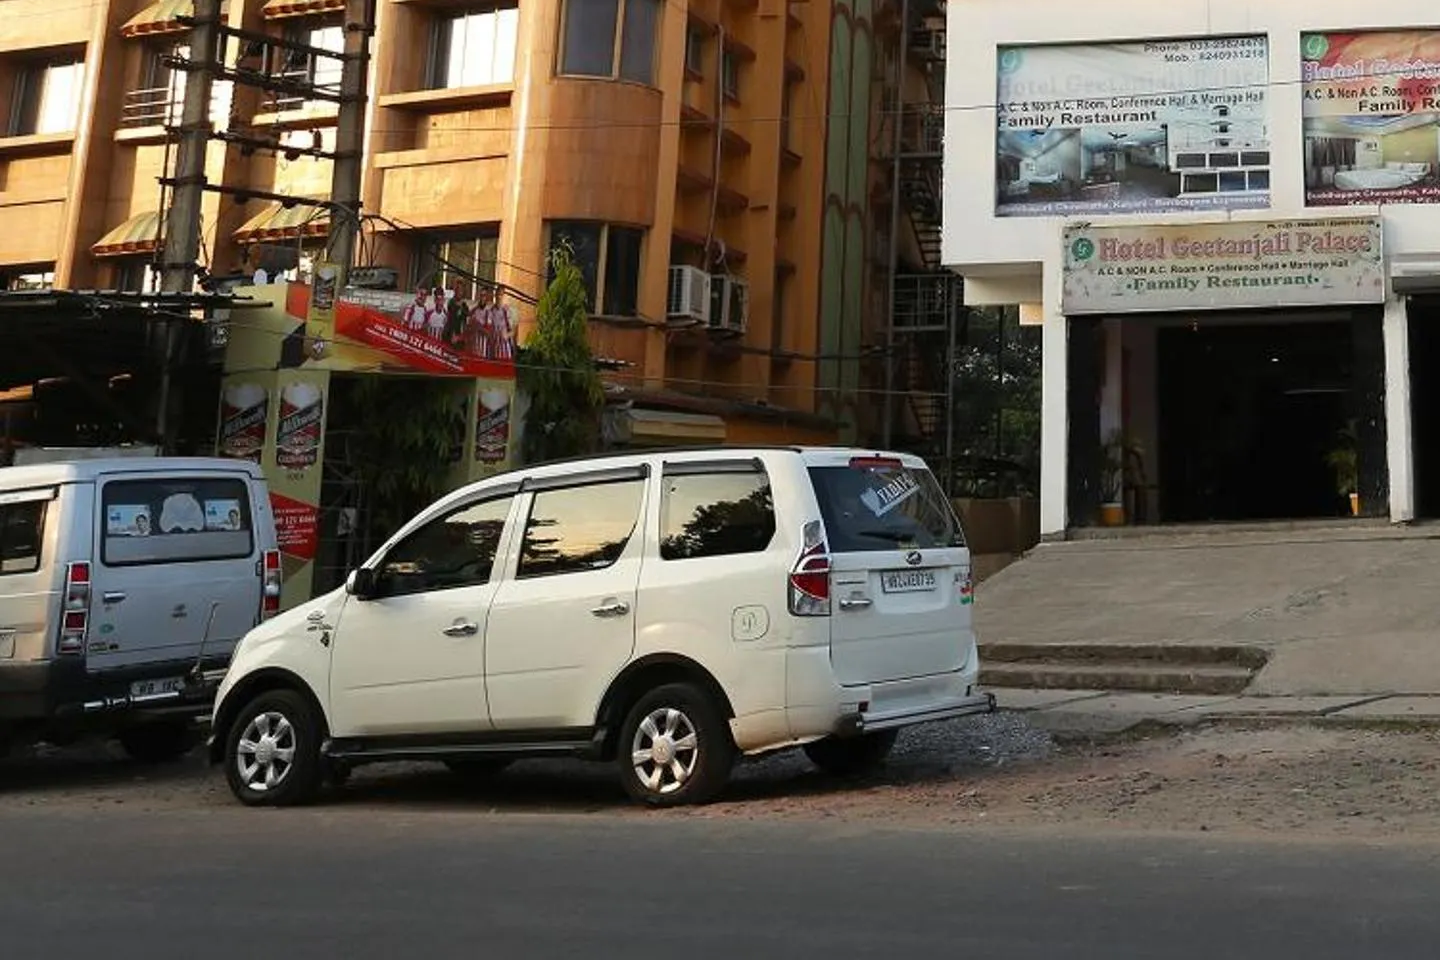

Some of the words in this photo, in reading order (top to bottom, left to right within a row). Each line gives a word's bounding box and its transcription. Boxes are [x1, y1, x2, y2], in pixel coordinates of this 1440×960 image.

[1021, 102, 1029, 112] &
[1111, 96, 1166, 109] Conference
[1191, 94, 1198, 105] &
[1201, 93, 1243, 105] Marriage
[1245, 91, 1264, 102] Hall
[1328, 87, 1335, 99] &
[1338, 87, 1358, 99] Non
[1358, 99, 1416, 113] Family
[998, 114, 1055, 128] Family
[1061, 110, 1157, 125] Restaurant
[1099, 237, 1165, 262] Hotel
[1171, 232, 1290, 260] Geetanjali
[1295, 230, 1371, 254] Palace
[1171, 264, 1197, 273] Room
[1207, 263, 1260, 273] Conference
[1261, 262, 1279, 271] Hall
[1290, 260, 1329, 271] Marriage
[1134, 277, 1200, 292] Family
[1207, 273, 1312, 289] Restaurant
